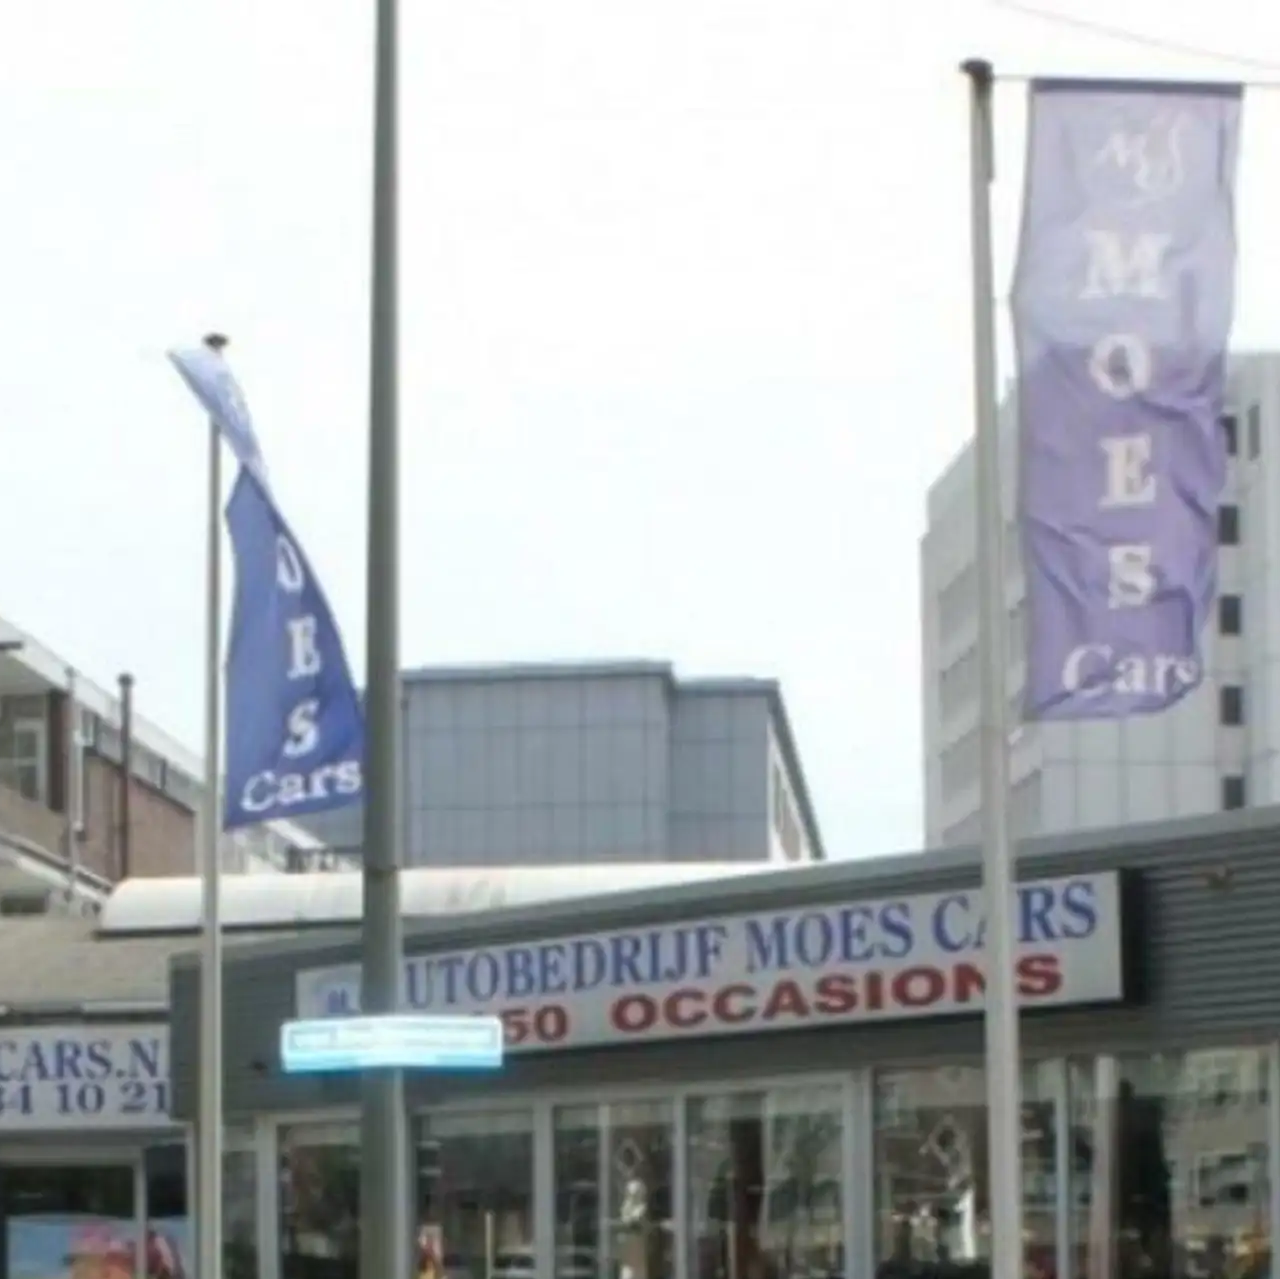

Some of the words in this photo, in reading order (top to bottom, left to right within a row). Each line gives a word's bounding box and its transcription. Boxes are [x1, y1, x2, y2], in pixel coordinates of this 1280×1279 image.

[1078, 230, 1170, 608] MOES
[241, 760, 363, 813] Cars
[404, 925, 728, 1008] UTOBEDRIJF
[745, 902, 915, 974] MOES
[502, 1002, 570, 1044] 50
[610, 953, 1063, 1035] OCCASIONS
[56, 1083, 106, 1116] 10
[119, 1081, 168, 1115] 21
